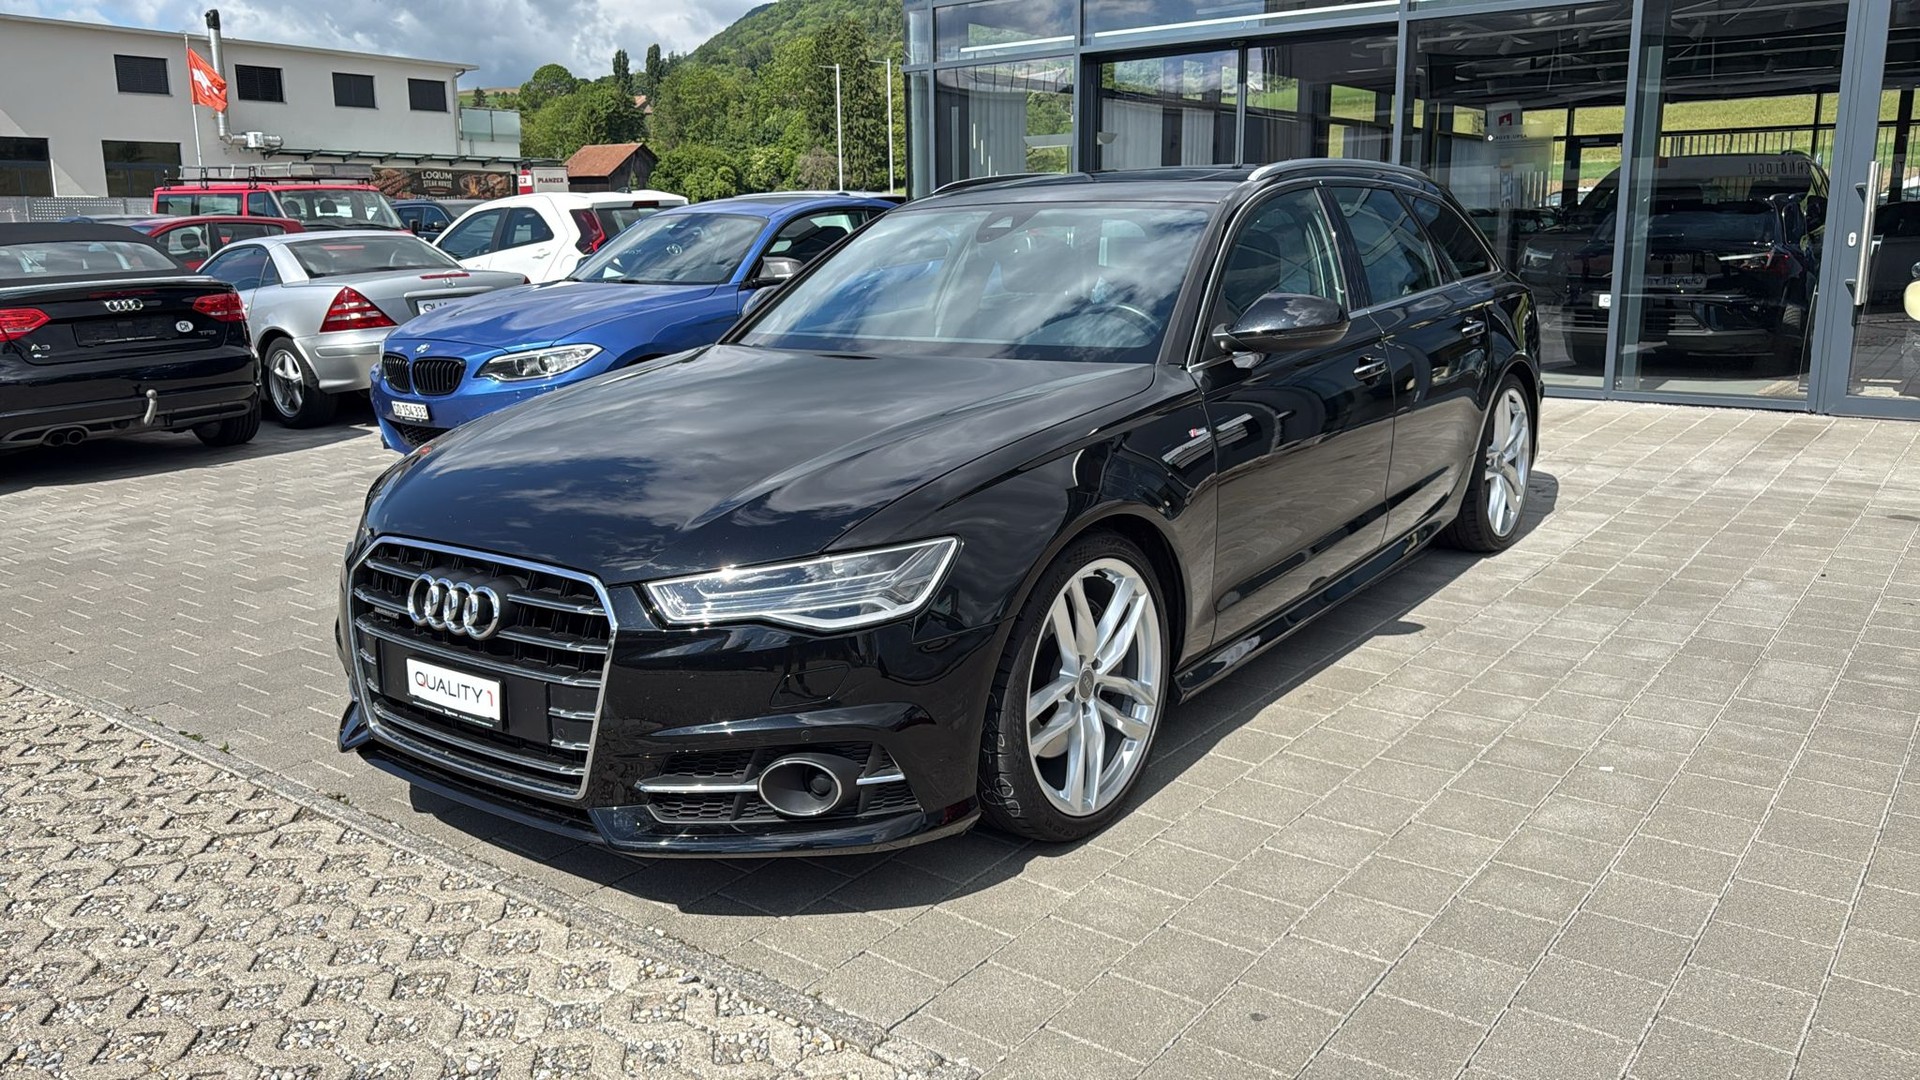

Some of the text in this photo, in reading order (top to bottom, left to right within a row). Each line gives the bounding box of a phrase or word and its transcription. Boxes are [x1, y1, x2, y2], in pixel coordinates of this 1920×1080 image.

[421, 171, 453, 180] LOQUM
[423, 180, 453, 189] STEAK HOUSE
[179, 322, 190, 331] CH
[415, 671, 483, 704] QUALITY
